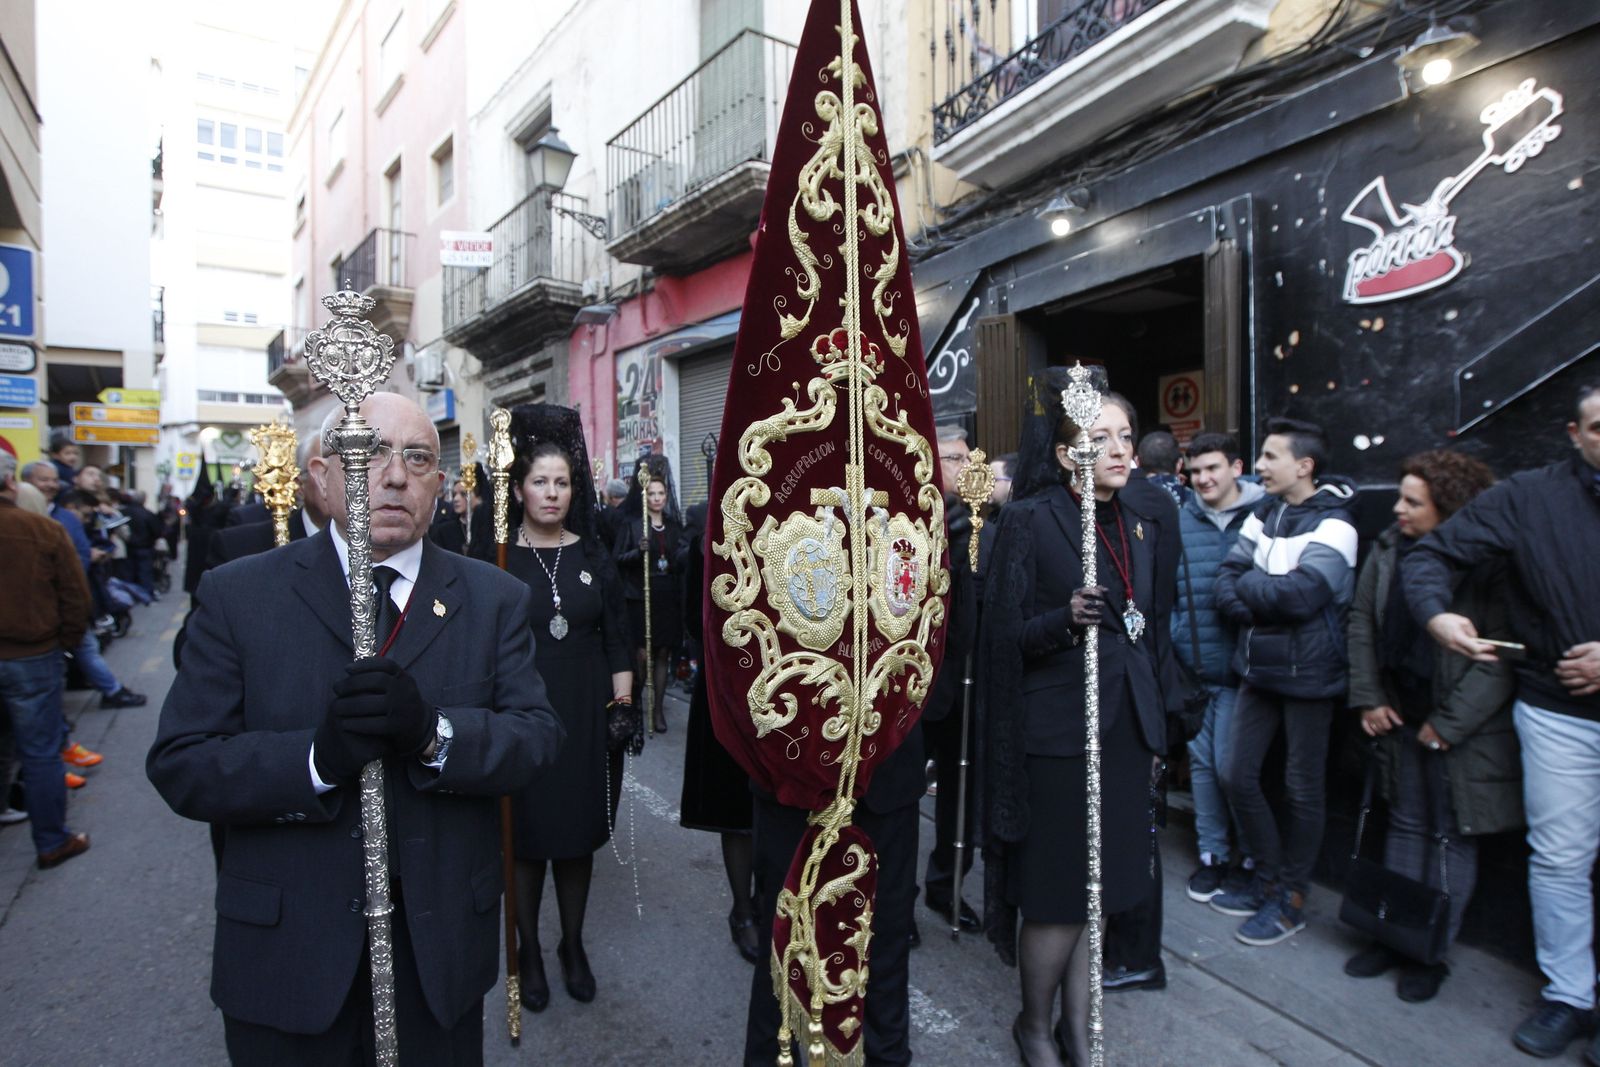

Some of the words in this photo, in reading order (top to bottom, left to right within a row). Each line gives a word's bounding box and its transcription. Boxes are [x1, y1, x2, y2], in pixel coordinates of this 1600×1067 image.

[624, 418, 659, 440] HORAS
[775, 441, 835, 503] AGRUPACION
[838, 637, 884, 658] ALRIA
